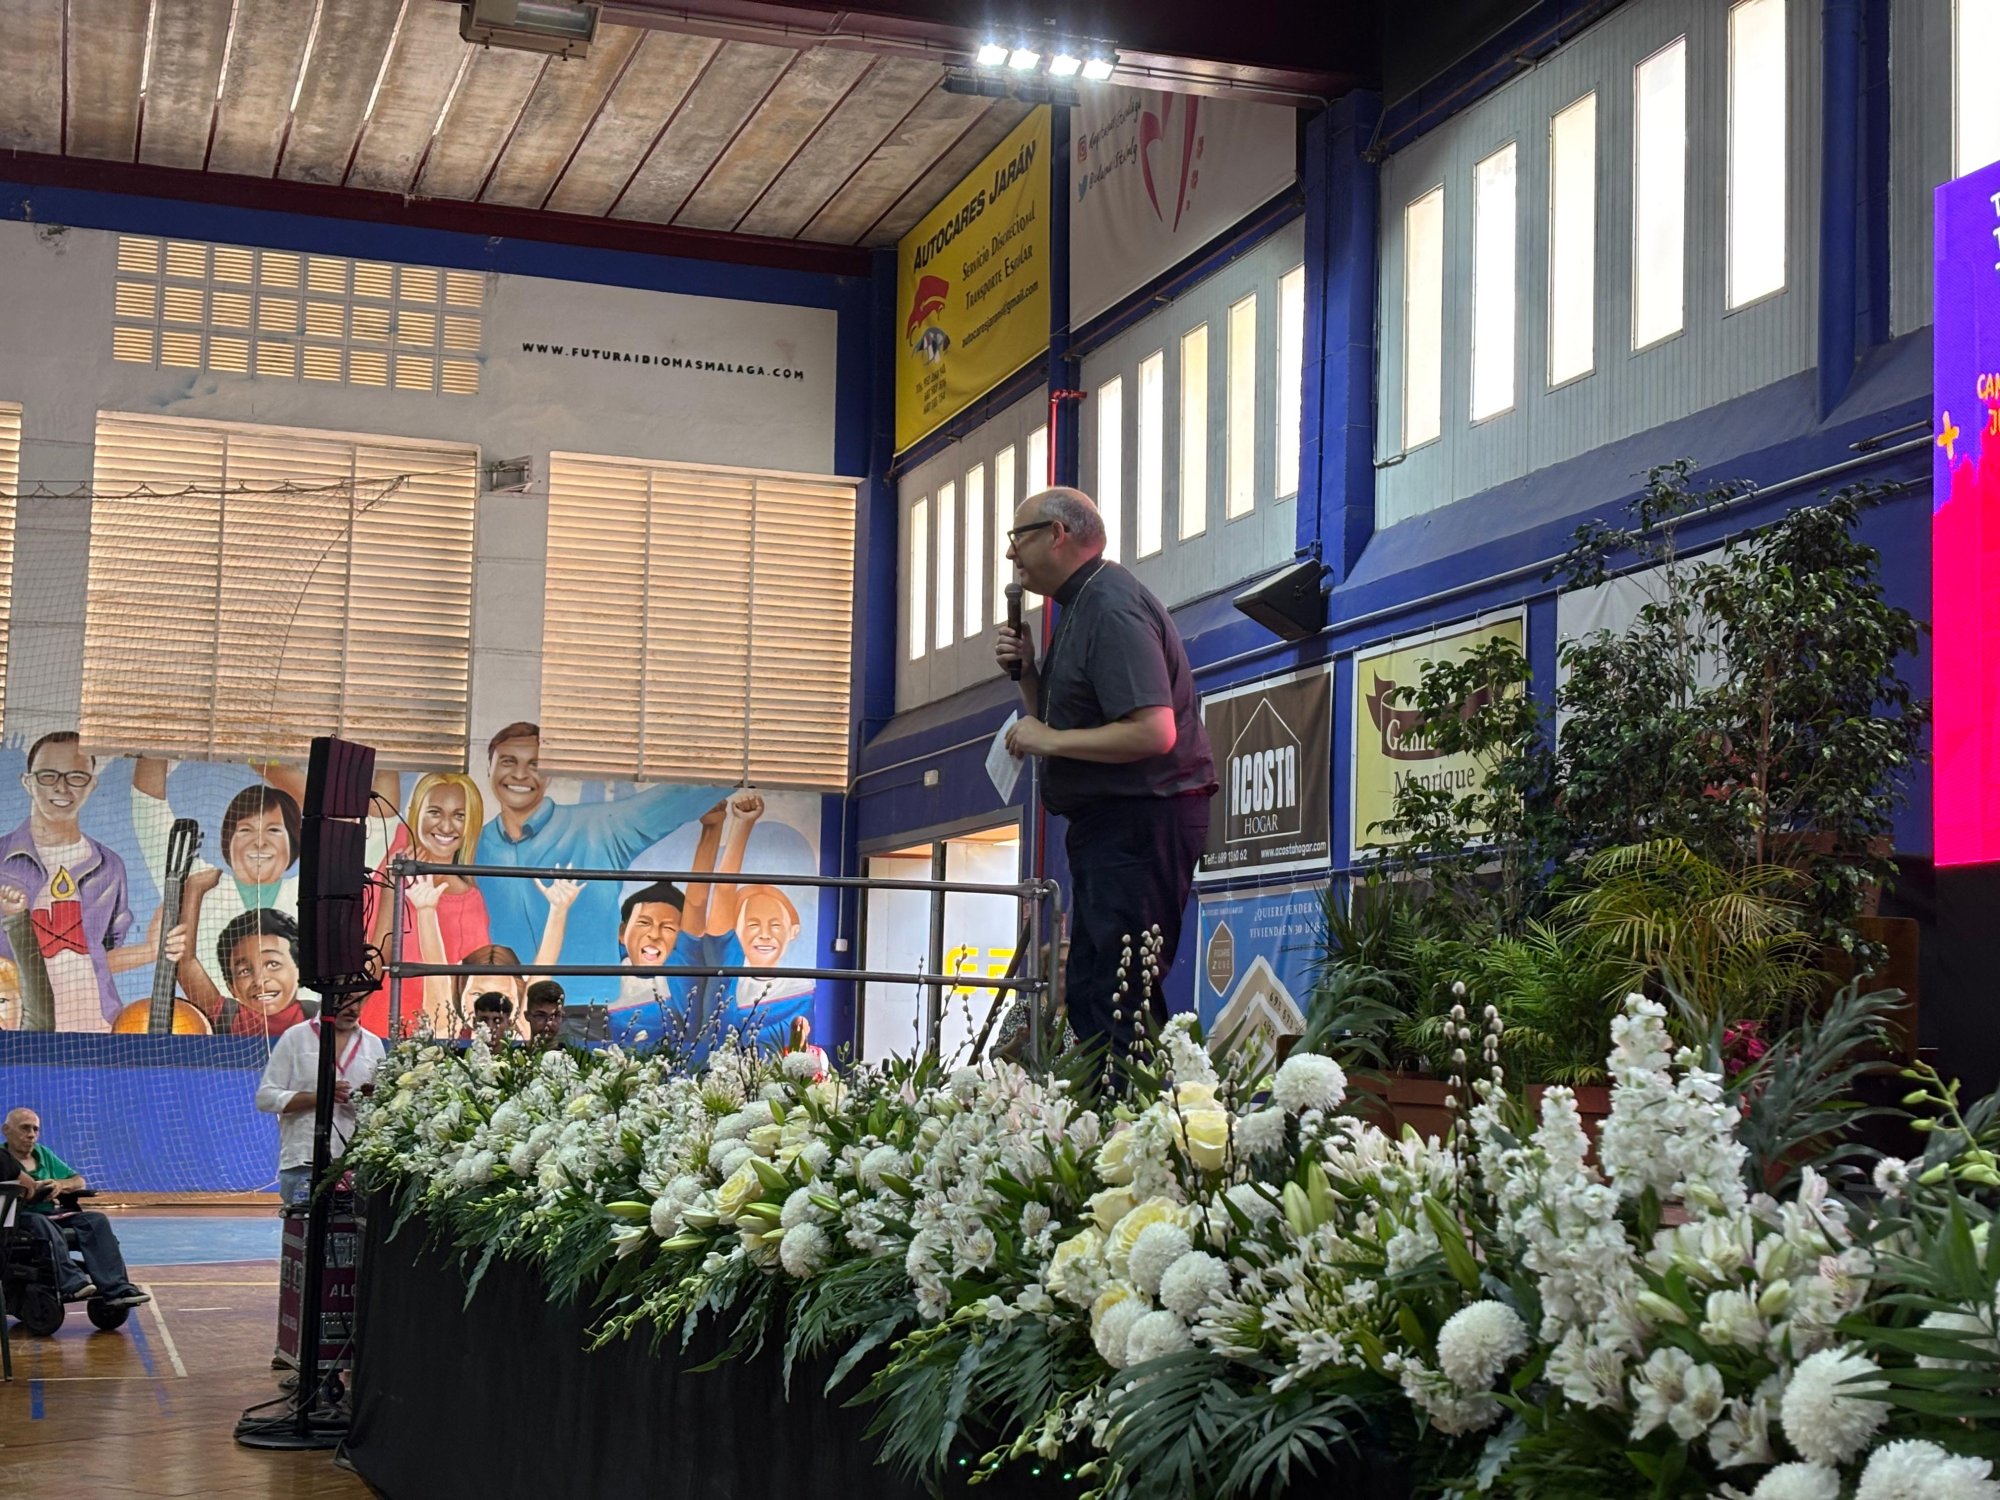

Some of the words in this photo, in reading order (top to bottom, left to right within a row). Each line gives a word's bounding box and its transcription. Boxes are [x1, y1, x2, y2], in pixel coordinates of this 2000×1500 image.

[913, 189, 987, 274] AUTOCARES
[989, 140, 1036, 205] JARÁN
[1231, 745, 1296, 816] ACOSTA
[1244, 814, 1279, 835] HOGAR
[1260, 841, 1327, 859] www.acostahogar.com
